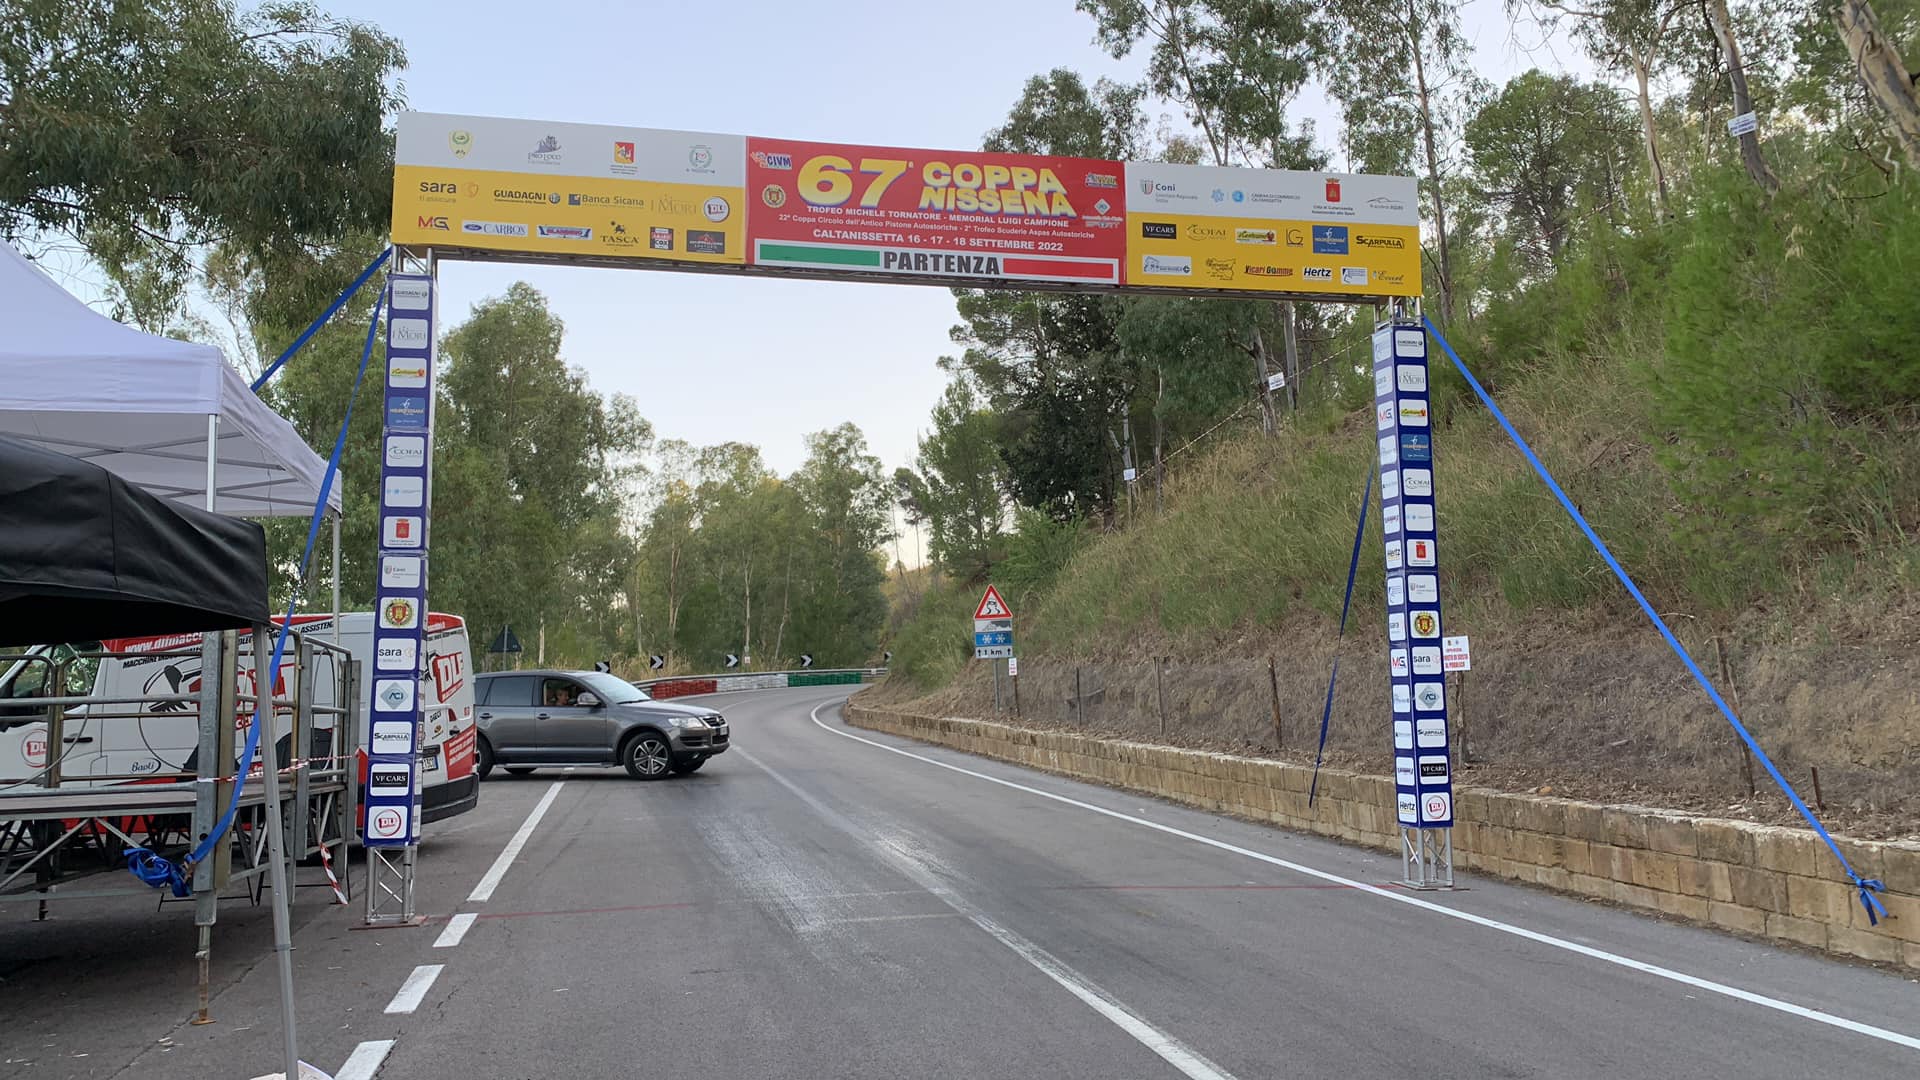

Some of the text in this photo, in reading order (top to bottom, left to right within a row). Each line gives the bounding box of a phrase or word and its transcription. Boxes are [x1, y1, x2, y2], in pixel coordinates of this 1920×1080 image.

[768, 154, 792, 168] CIVM
[923, 162, 1067, 194] COPPA
[420, 182, 457, 194] sara
[1155, 183, 1176, 192] Coni
[494, 189, 546, 201] GUADAGNI
[582, 194, 644, 206] Banca Sicana
[919, 186, 1077, 218] NISSENA
[418, 215, 450, 231] MG
[807, 206, 843, 216] TROFEO
[846, 208, 885, 218] MICHELE
[888, 210, 941, 221] TORNATORE
[949, 214, 995, 224] MEMORIAL
[998, 216, 1021, 225] LUIGI
[1024, 218, 1069, 228] CAMPIONE
[792, 214, 816, 224] Coppa
[818, 216, 844, 225] Circolo
[846, 218, 884, 228] dell'Antico
[885, 220, 912, 230] Pistone
[914, 222, 958, 233] Autostoriche
[974, 225, 996, 234] Trofeo
[997, 226, 1027, 236] Scuderie
[1028, 228, 1050, 238] Aspas
[1052, 230, 1095, 240] Autostoriche
[1156, 226, 1175, 234] CARS
[600, 236, 639, 244] TASCA
[813, 229, 904, 244] CALTANISSETTA
[908, 235, 920, 244] 16
[930, 236, 943, 246] 17
[953, 238, 966, 247] 18
[969, 238, 1035, 251] SETTEMBRE
[1038, 242, 1064, 252] 2022
[1356, 236, 1404, 249] SCARPULLA
[883, 251, 1001, 275] PARTENZA
[1245, 264, 1266, 274] Vicari
[1266, 266, 1293, 276] Gomme
[1304, 267, 1332, 278] Hertz
[378, 647, 402, 656] sara
[1392, 656, 1405, 668] MG
[388, 692, 404, 700] ACI
[374, 732, 410, 742] SCARPULLA
[1399, 801, 1415, 811] Hertz
